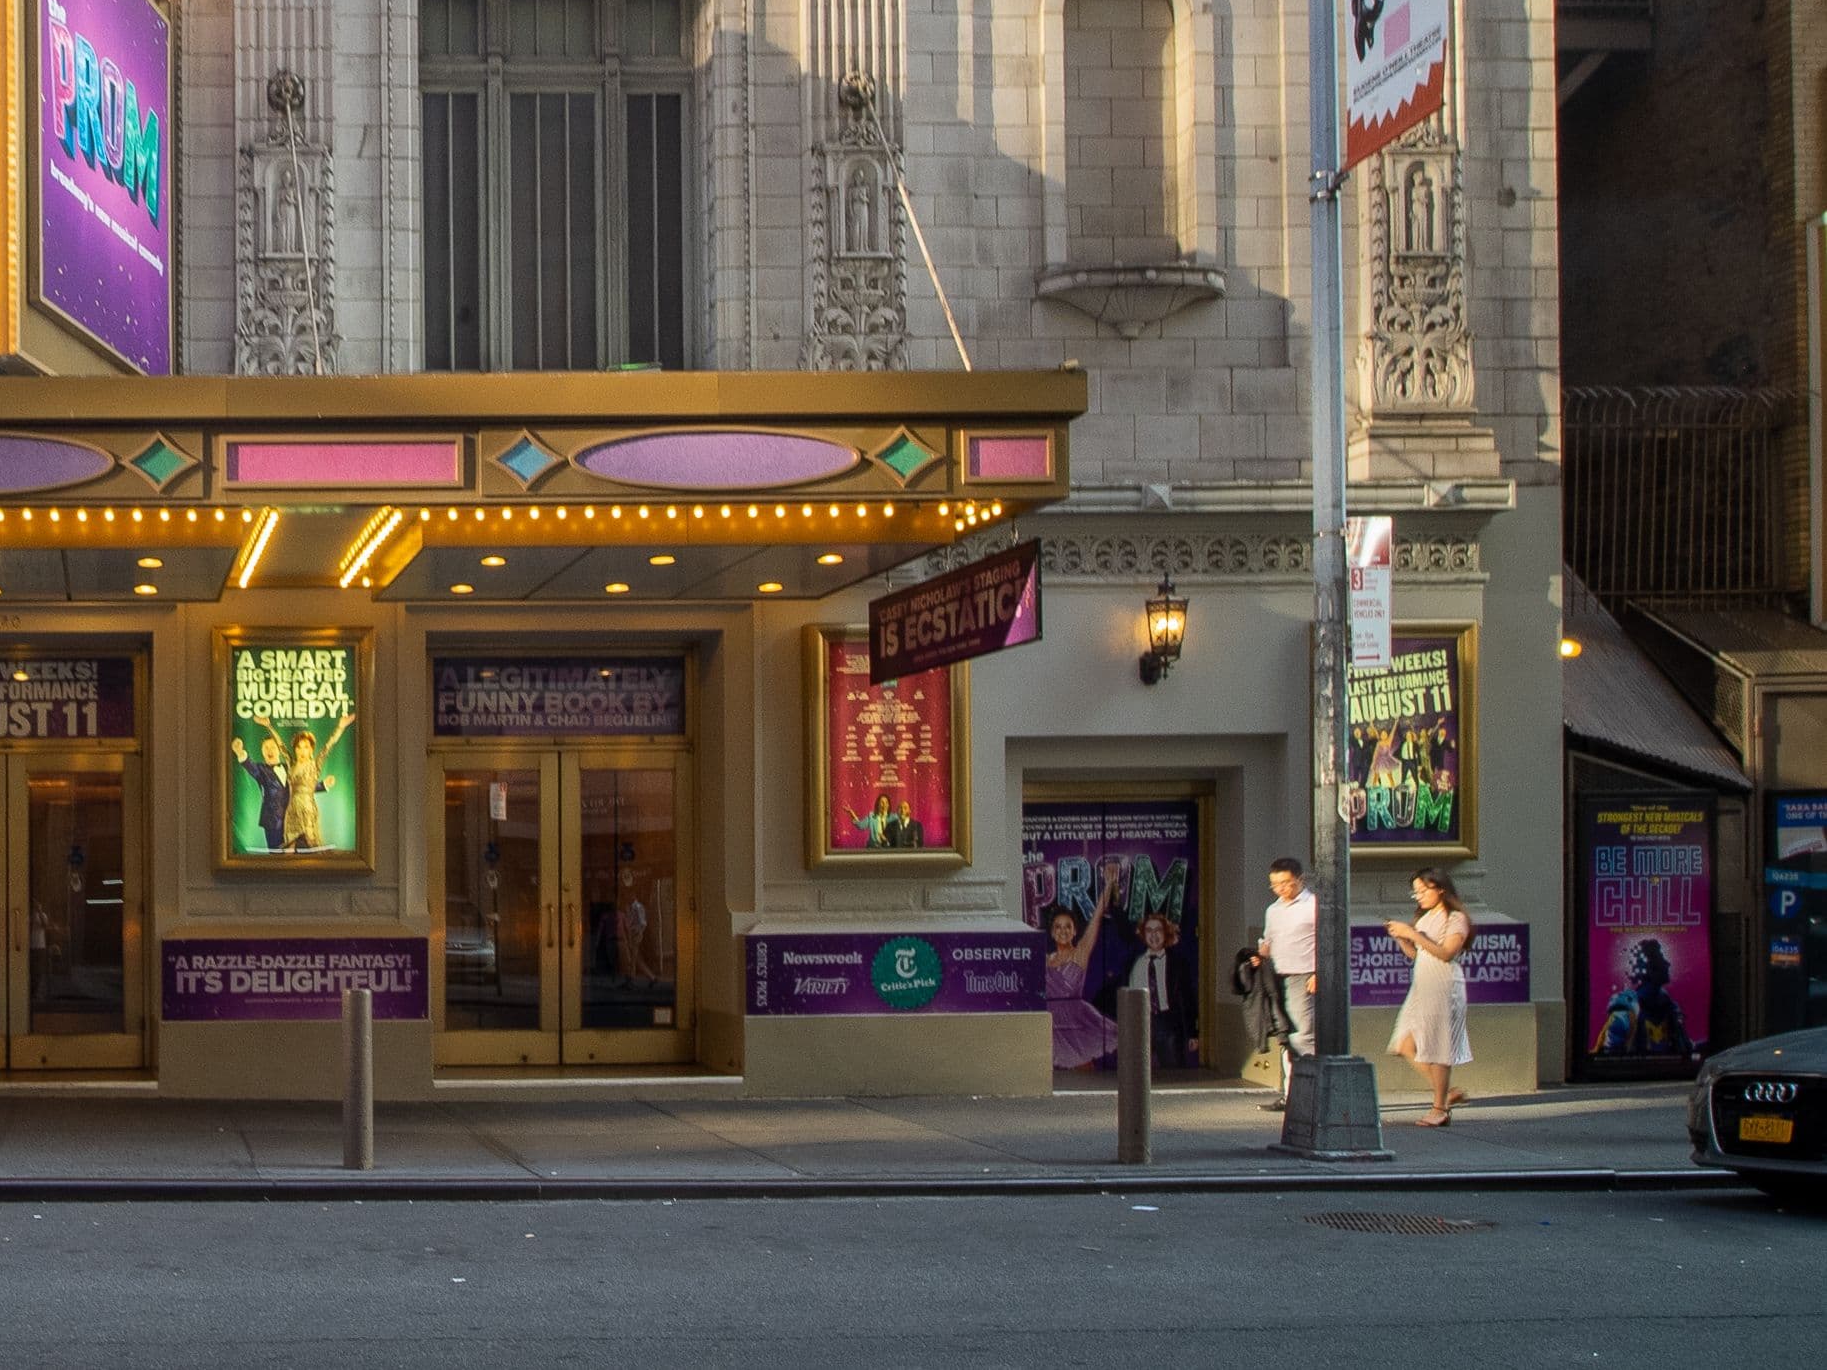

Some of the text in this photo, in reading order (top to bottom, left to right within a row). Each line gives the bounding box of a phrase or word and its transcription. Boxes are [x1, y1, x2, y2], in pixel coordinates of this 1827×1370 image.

[47, 17, 160, 230] PROM
[974, 559, 1021, 589] STAGING
[1352, 568, 1362, 590] 3
[879, 621, 899, 659] IS
[0, 661, 99, 680] WEEKS!
[260, 649, 346, 671] SMART,
[1391, 649, 1447, 673] WEEKS!
[236, 668, 346, 683] BIG-HEARTED
[467, 667, 672, 691] LEGITIMATELY
[1348, 669, 1449, 697] LAST PERFORMANCE
[237, 682, 349, 701] MUSICAL
[437, 692, 672, 713] FUNNY BOOK BY
[1350, 685, 1452, 725] AUGUST 11
[62, 701, 98, 737] 11
[437, 714, 590, 727] BOB MARTIN & CHAD
[1349, 785, 1454, 833] PROM
[1597, 811, 1644, 823] STRONGEST
[1645, 811, 1663, 823] NEW
[1023, 832, 1042, 841] BUT
[1043, 832, 1053, 840] A
[1054, 831, 1085, 840] LITTLE
[1087, 831, 1102, 840] BIT
[1105, 831, 1120, 840] OF
[1619, 823, 1631, 835] OF
[1595, 845, 1702, 876] BE MORE
[1023, 854, 1189, 930] PROM
[1595, 876, 1702, 927] CHILL
[1781, 890, 1796, 916] P
[952, 947, 1033, 961] OBSERVER
[1369, 935, 1403, 952] WI
[192, 955, 326, 969] RAZZLE-DAZZLE
[329, 954, 412, 968] FANTASY!
[782, 951, 863, 966] Newsweek
[1486, 951, 1521, 964] AND
[176, 970, 224, 995] IT'S
[793, 977, 852, 996] VARIETY
[913, 977, 936, 990] Pick
[1350, 968, 1414, 985] EARTE
[756, 981, 768, 1007] PICKS
